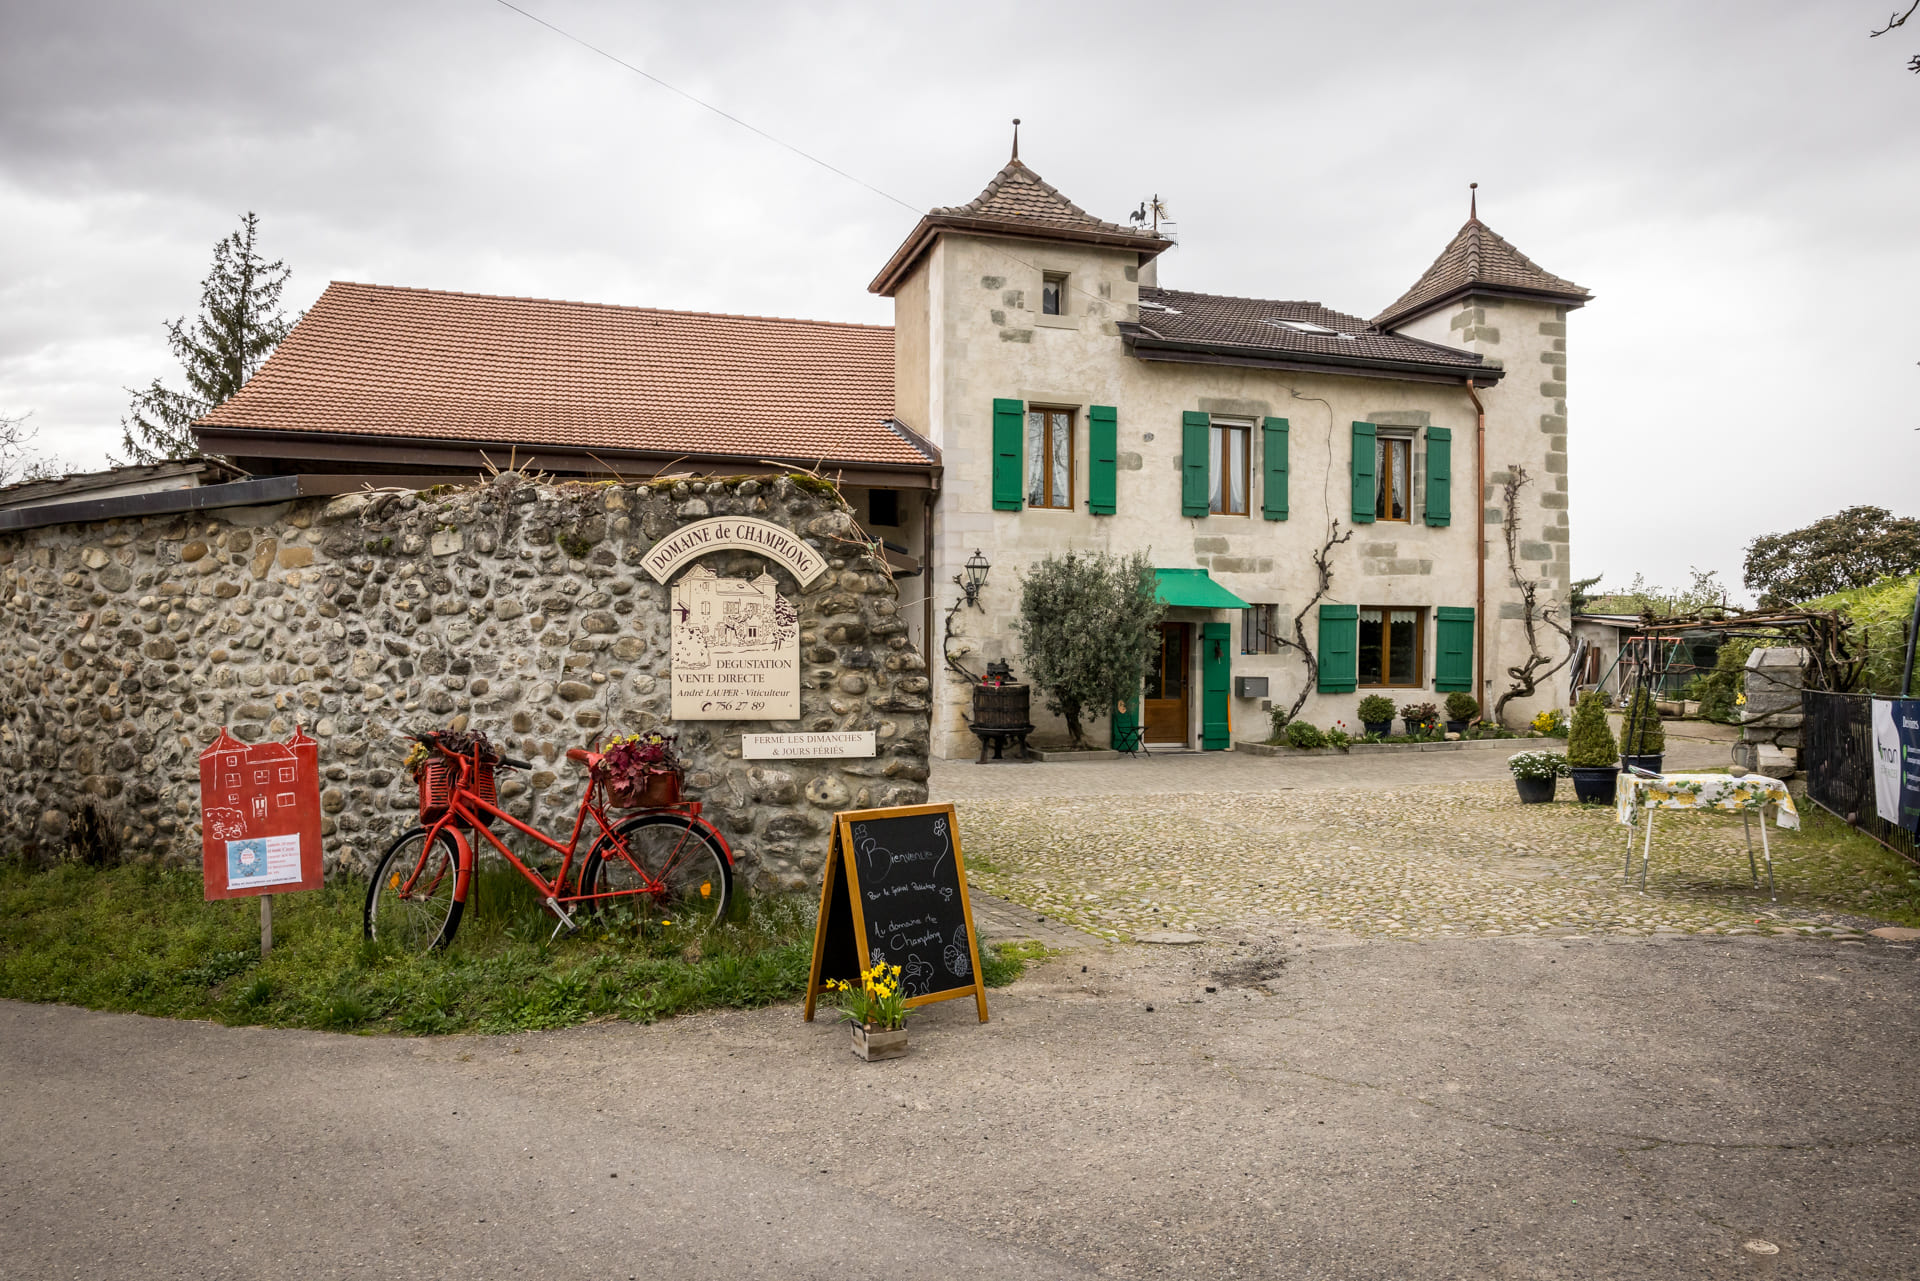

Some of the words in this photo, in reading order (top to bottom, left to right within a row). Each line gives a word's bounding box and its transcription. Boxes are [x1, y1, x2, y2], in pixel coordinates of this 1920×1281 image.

[652, 527, 711, 570] DOMAINE
[715, 523, 731, 539] de
[736, 524, 813, 573] CHAMPLONG
[716, 659, 792, 669] DEGUSTATION
[677, 673, 715, 683] VENTE
[718, 673, 765, 683] DIRECTE
[677, 688, 704, 697] André
[705, 688, 739, 697] LAUPER
[746, 688, 791, 697] Viticulteur
[715, 701, 733, 711] 756
[735, 701, 749, 711] 27
[751, 701, 766, 711] 89
[787, 735, 805, 744] LES
[807, 734, 863, 743] DIMANCHES
[772, 748, 779, 756] &
[782, 747, 811, 756] JOURS
[861, 837, 933, 882] Bienvenue
[890, 930, 943, 950] Champlong
